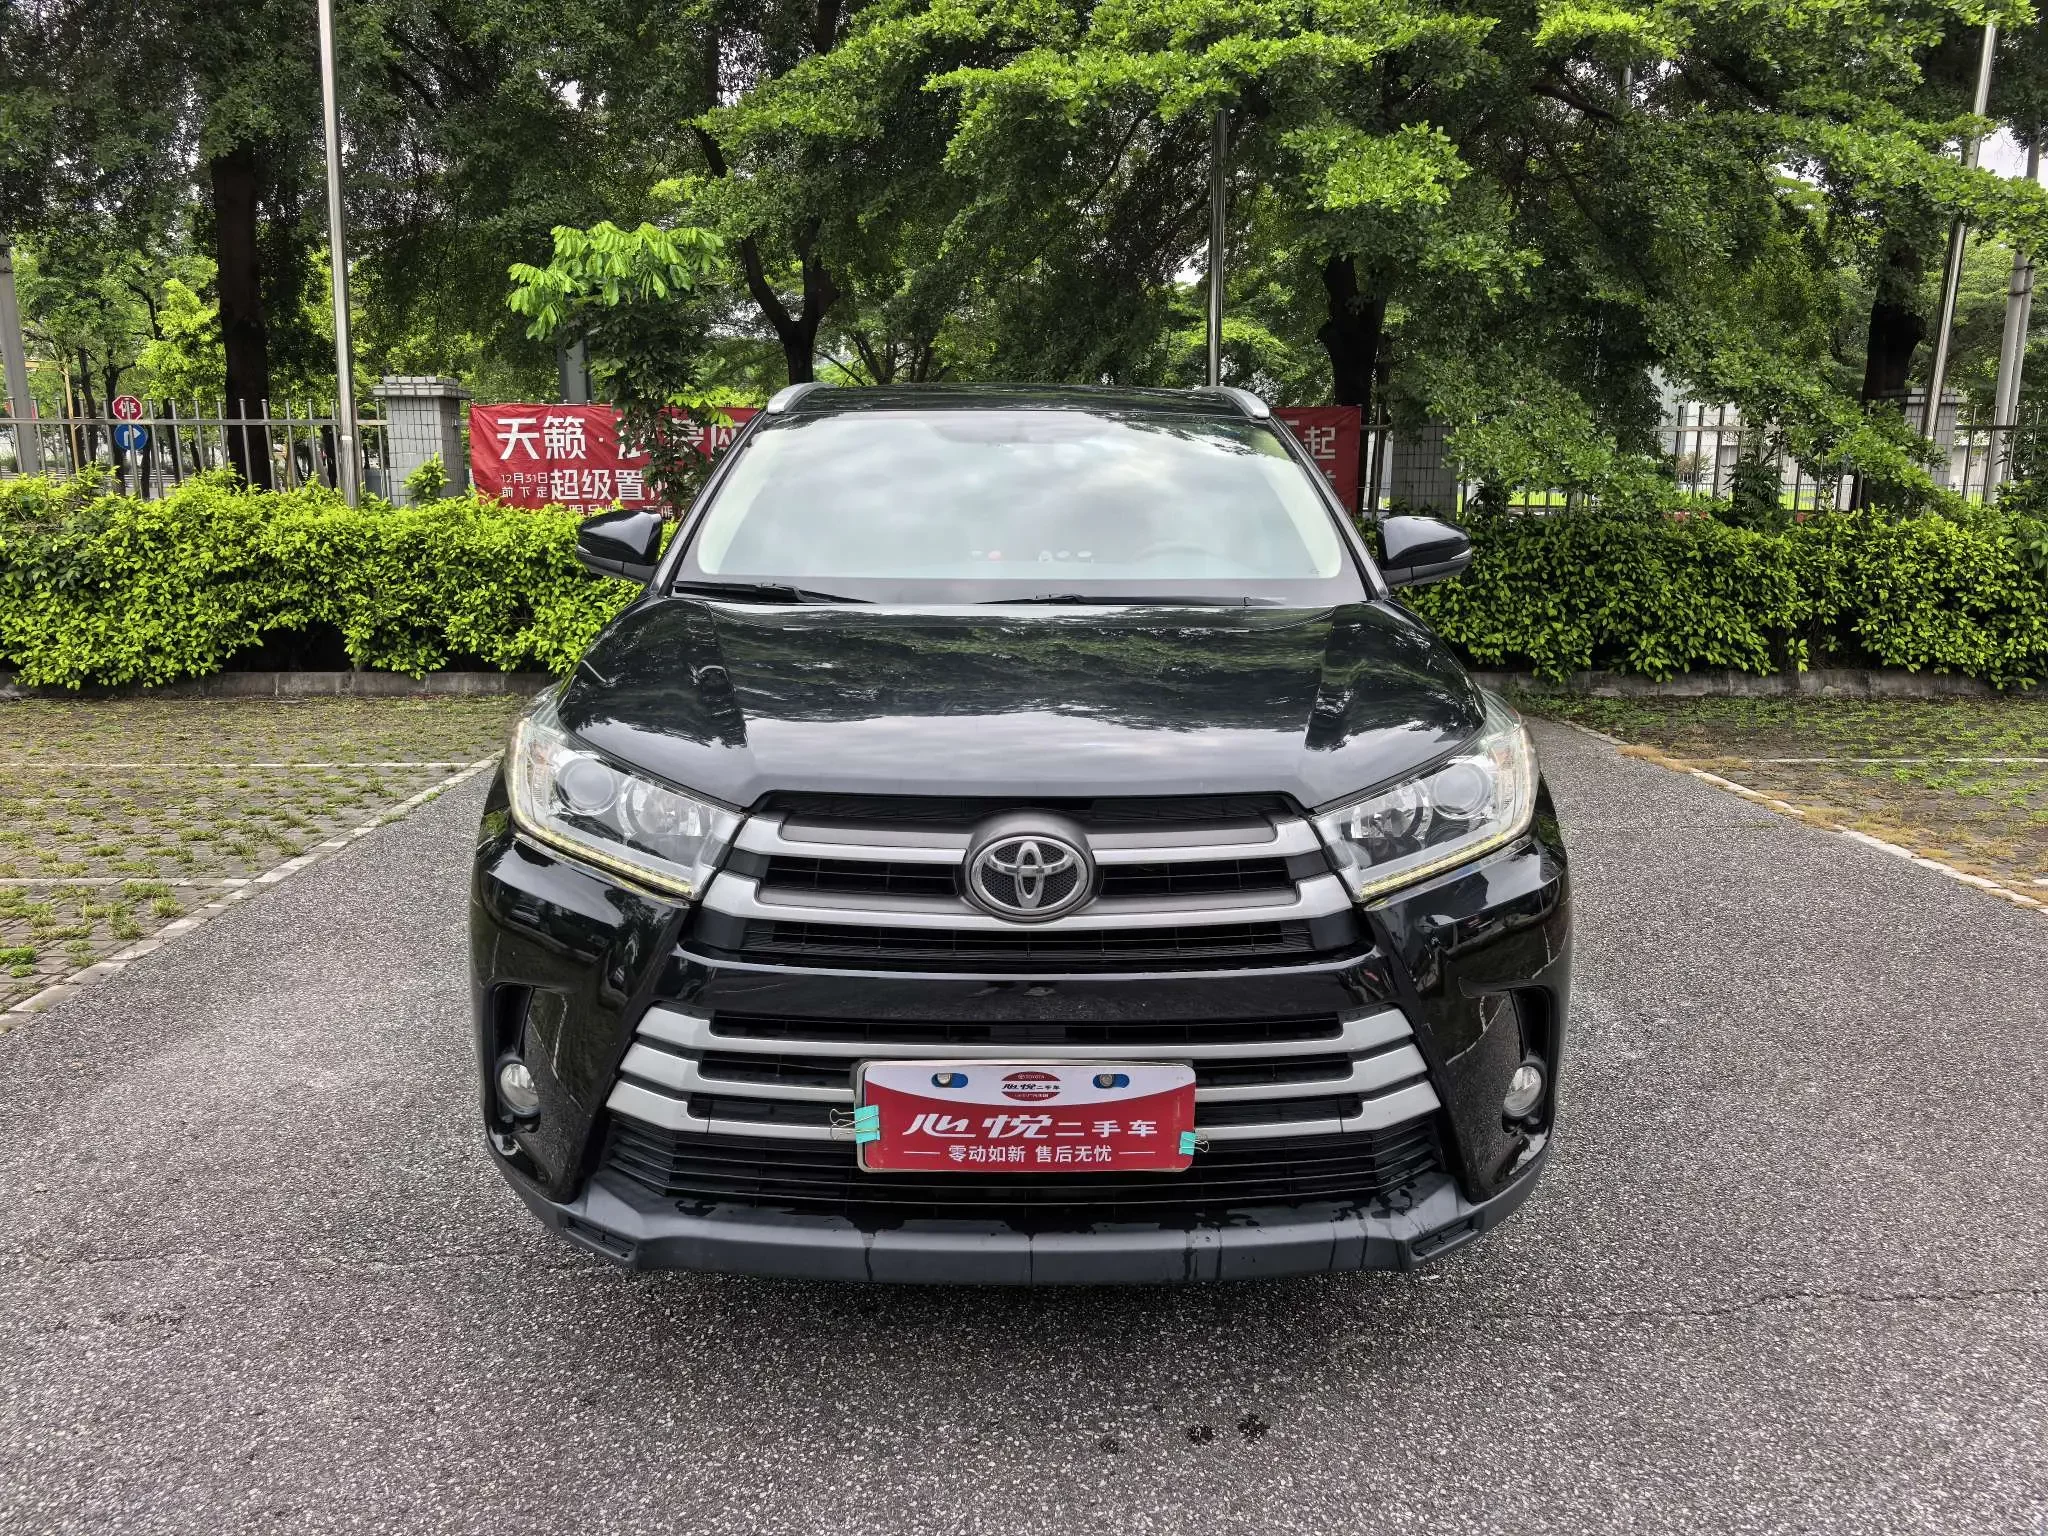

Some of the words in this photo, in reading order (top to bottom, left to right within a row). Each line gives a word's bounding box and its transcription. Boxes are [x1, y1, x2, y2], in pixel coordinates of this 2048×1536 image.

[501, 472, 548, 485] 12月31日
[550, 468, 667, 501] 超级置
[948, 1145, 1026, 1163] 零动如新
[1035, 1145, 1112, 1163] 售后无忧
